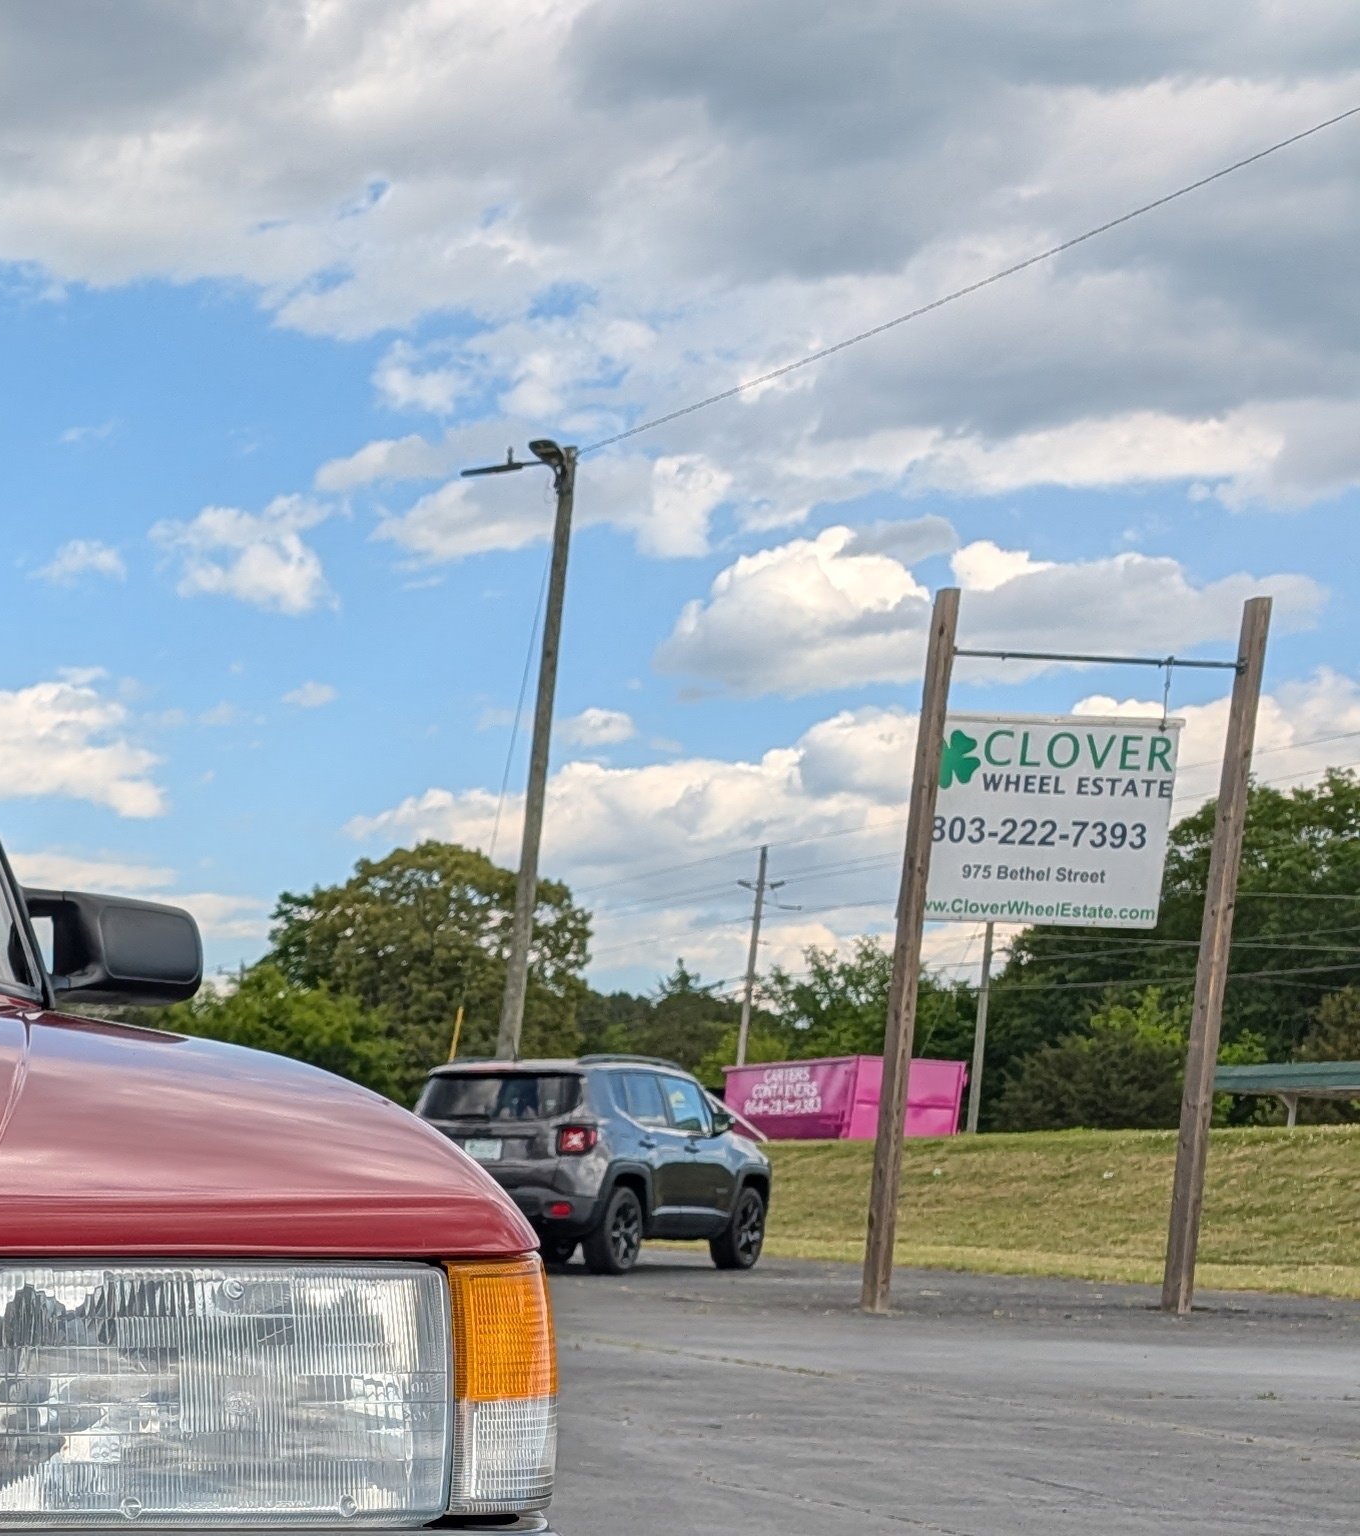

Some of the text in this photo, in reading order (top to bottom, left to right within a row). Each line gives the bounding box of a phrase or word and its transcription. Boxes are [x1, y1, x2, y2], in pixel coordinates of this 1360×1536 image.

[983, 729, 1173, 772] CLOVER
[982, 773, 1173, 798] WHEEL ESTATE
[932, 815, 1147, 850] 803-222-7393
[962, 864, 1106, 884] 975 Bethel Street
[924, 898, 1155, 921] ww.CloverWheelEstate.com
